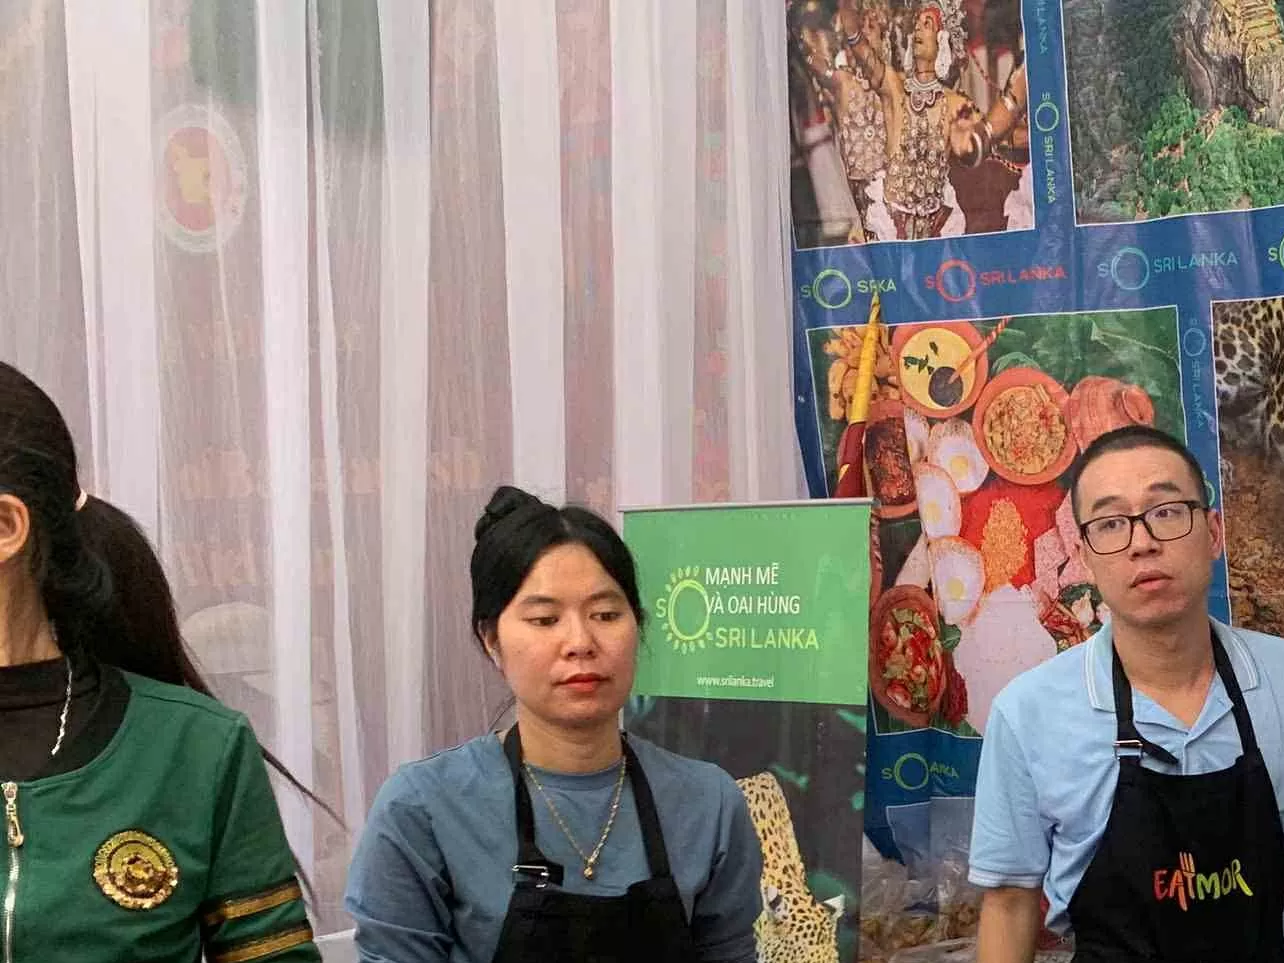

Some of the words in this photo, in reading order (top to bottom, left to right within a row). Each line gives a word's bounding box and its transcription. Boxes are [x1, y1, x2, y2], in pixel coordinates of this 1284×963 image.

[1006, 264, 1067, 283] LANKA
[1153, 255, 1176, 274] SRI
[1179, 250, 1238, 270] LANKA
[705, 566, 752, 590] MẠNH
[755, 562, 780, 585] MẼ
[728, 595, 753, 615] OAI
[757, 591, 801, 615] HÙNG
[715, 627, 746, 649] SRI
[750, 627, 820, 651] LANKA
[1153, 850, 1254, 912] EATMOR
